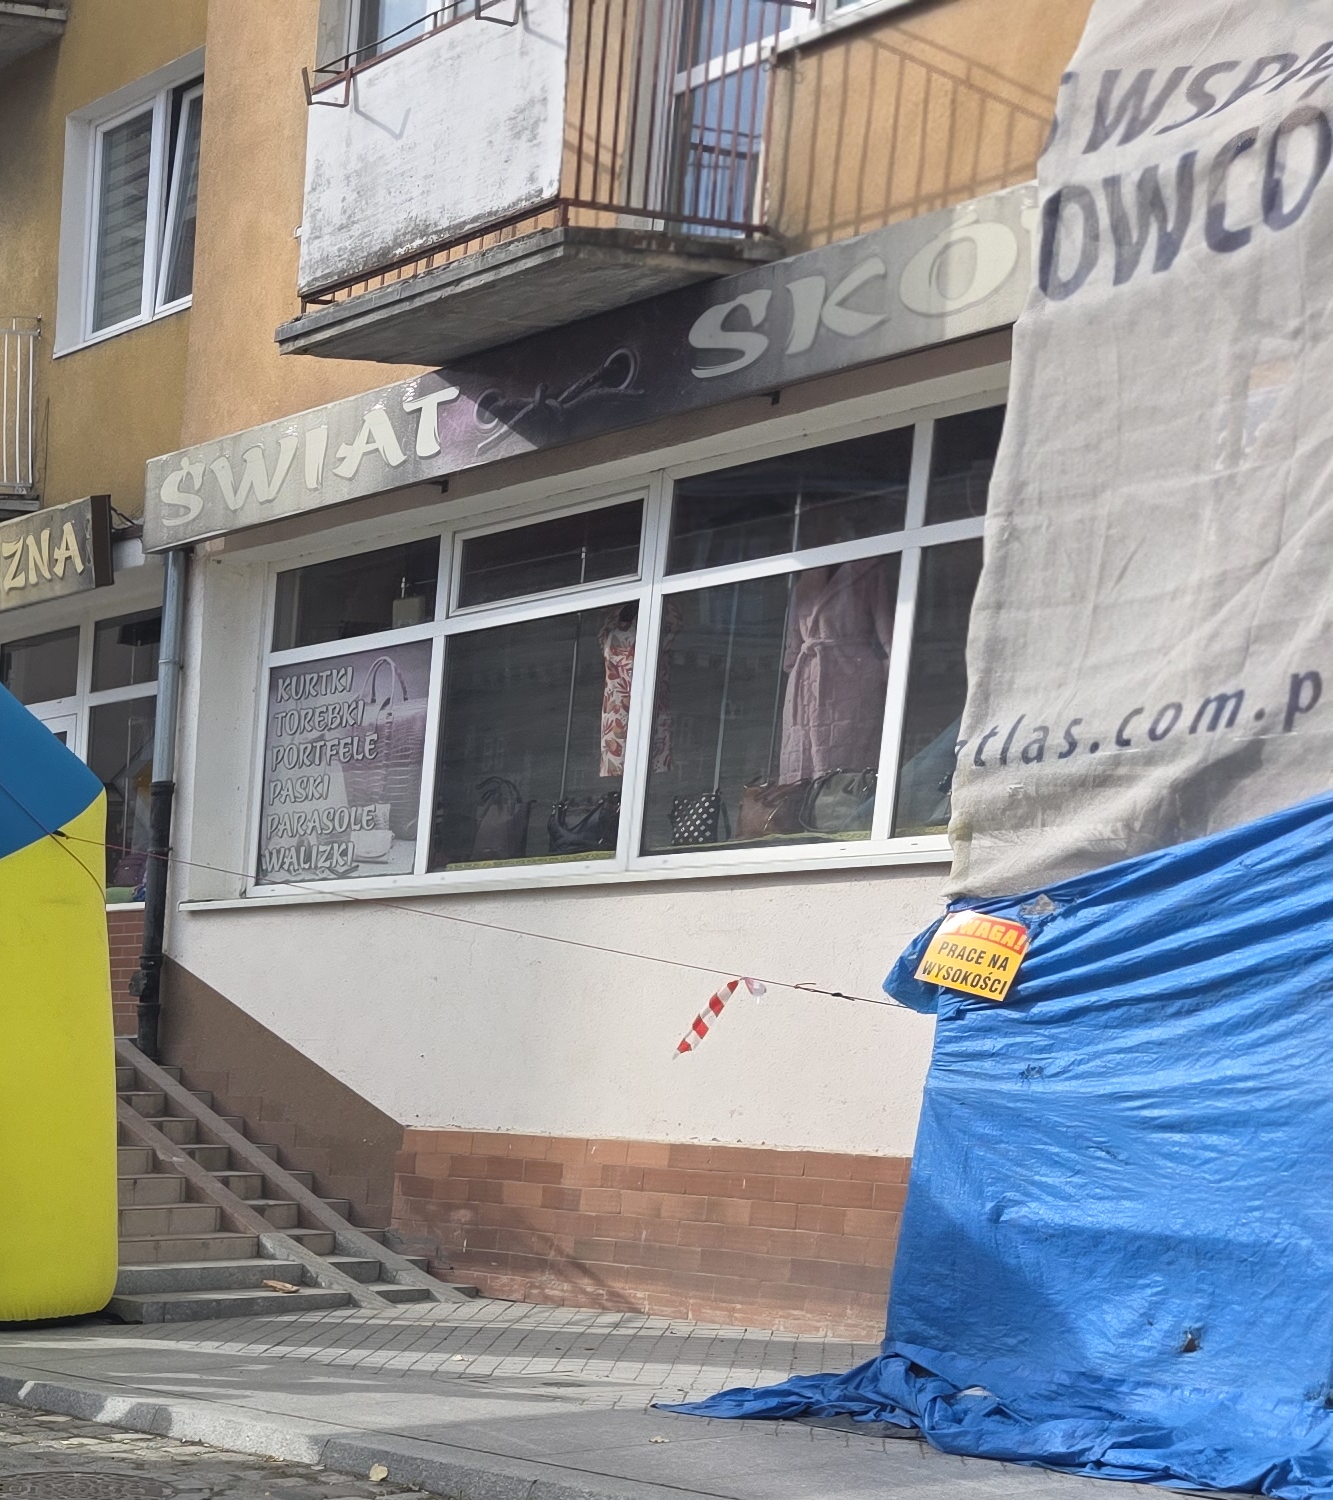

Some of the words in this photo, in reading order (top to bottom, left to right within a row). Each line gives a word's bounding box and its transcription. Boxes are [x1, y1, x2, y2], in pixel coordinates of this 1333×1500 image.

[688, 207, 1035, 379] SKÓ
[276, 666, 353, 703] KURTKI
[274, 700, 365, 736] TOREBKI
[271, 732, 378, 772] PORTFELE
[268, 774, 331, 805] PASKI
[266, 804, 377, 839] PARASOLE
[263, 841, 356, 873] WALIZKI
[947, 914, 1028, 951] WAGA!
[937, 941, 987, 966] PRACE
[987, 954, 1010, 972] NA
[922, 960, 1008, 995] WYSOKOŚCI
